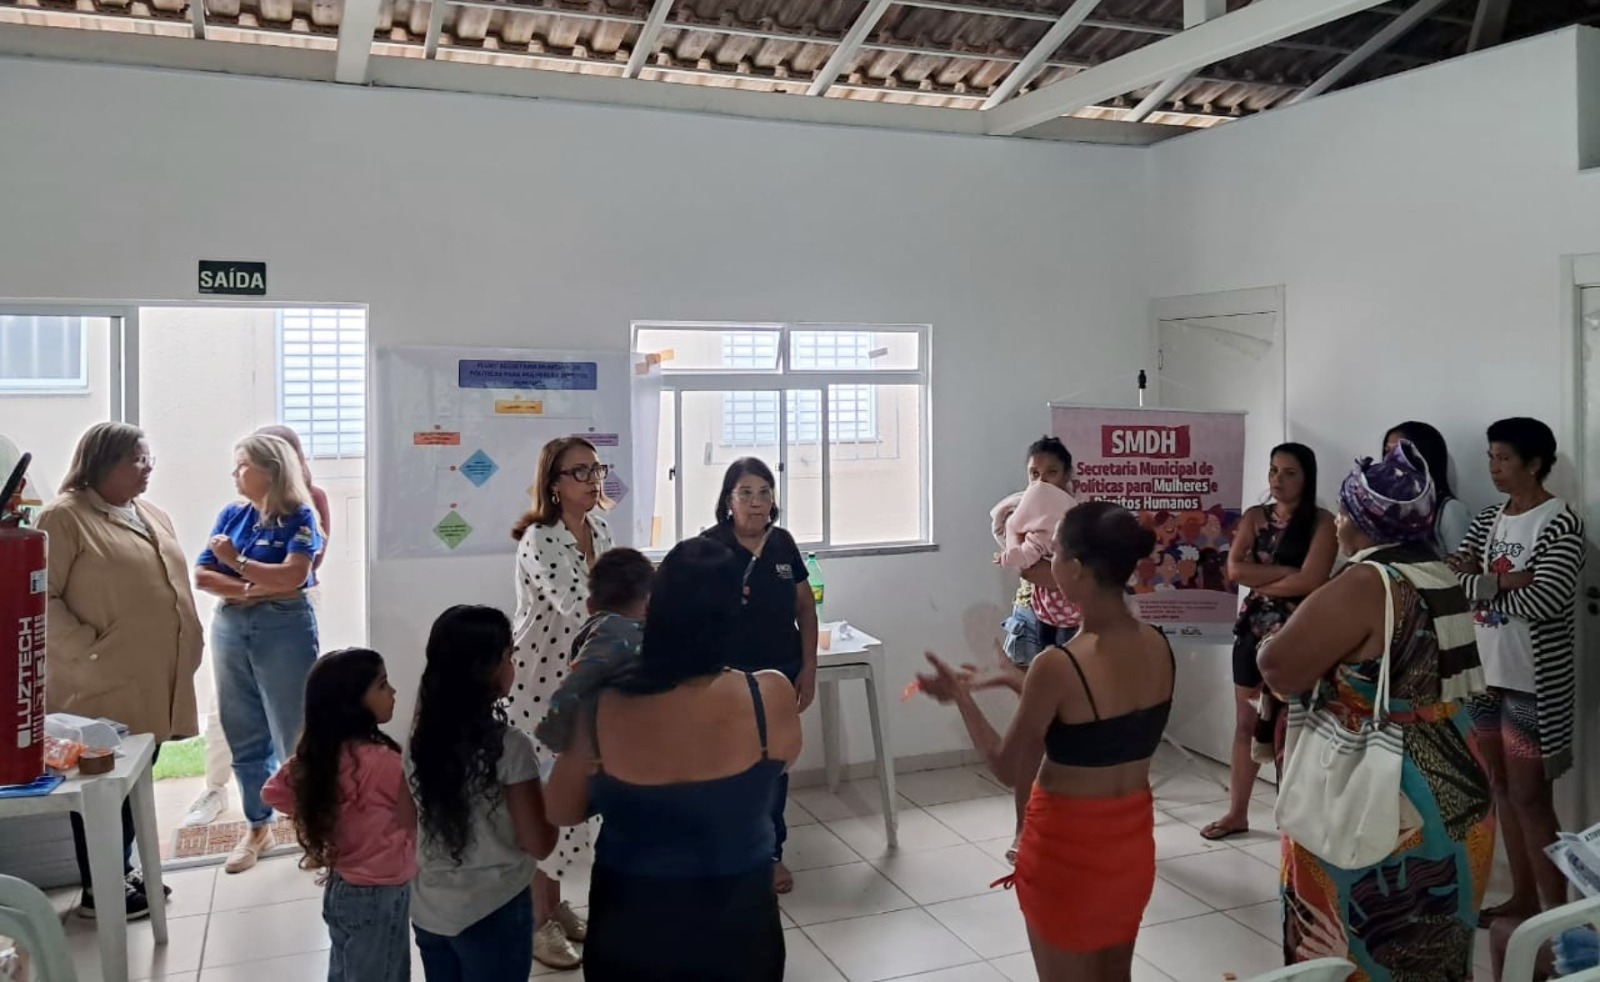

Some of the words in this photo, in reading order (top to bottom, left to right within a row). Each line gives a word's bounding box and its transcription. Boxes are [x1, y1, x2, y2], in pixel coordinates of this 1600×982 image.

[200, 267, 264, 288] SAÍDA
[1111, 429, 1176, 454] SMDH
[1076, 462, 1137, 475] Secretaria
[1140, 461, 1196, 479] Municipal
[1199, 461, 1213, 475] de
[1072, 478, 1124, 493] Políticas
[1126, 481, 1152, 495] para
[1154, 478, 1208, 492] Mulheres
[1211, 481, 1218, 492] e
[1143, 496, 1198, 509] Humanos
[17, 617, 33, 730] LUZTECH
